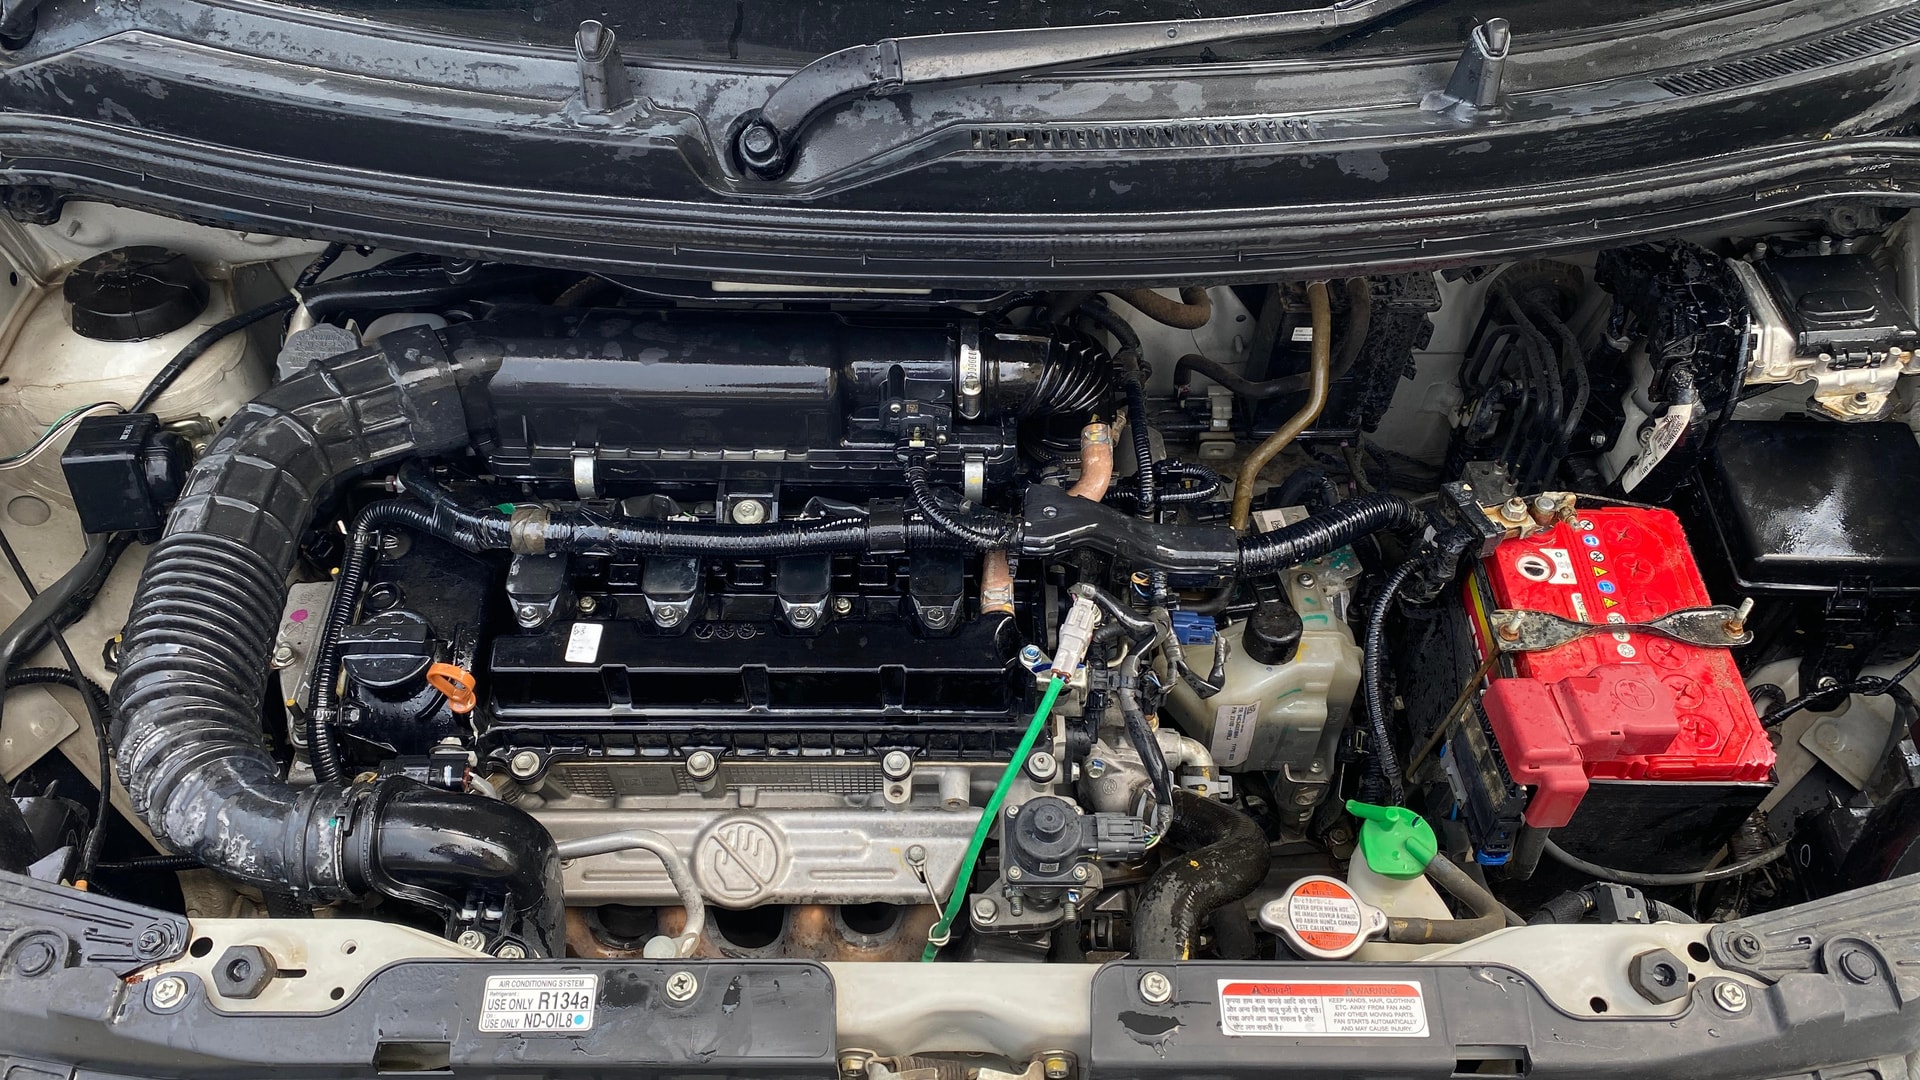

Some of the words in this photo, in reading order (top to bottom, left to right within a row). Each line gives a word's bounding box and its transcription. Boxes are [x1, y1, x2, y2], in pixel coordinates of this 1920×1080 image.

[499, 980, 510, 988] AIR
[511, 980, 557, 988] CONDITIONING
[558, 979, 585, 987] SYSTEM
[1355, 987, 1398, 995] WARNING
[487, 998, 506, 1010] USE
[508, 998, 534, 1010] ONLY
[538, 991, 589, 1010] R134a
[484, 1019, 499, 1029] USE
[500, 1018, 520, 1029] ONLY
[523, 1013, 573, 1028] ND-OIL8
